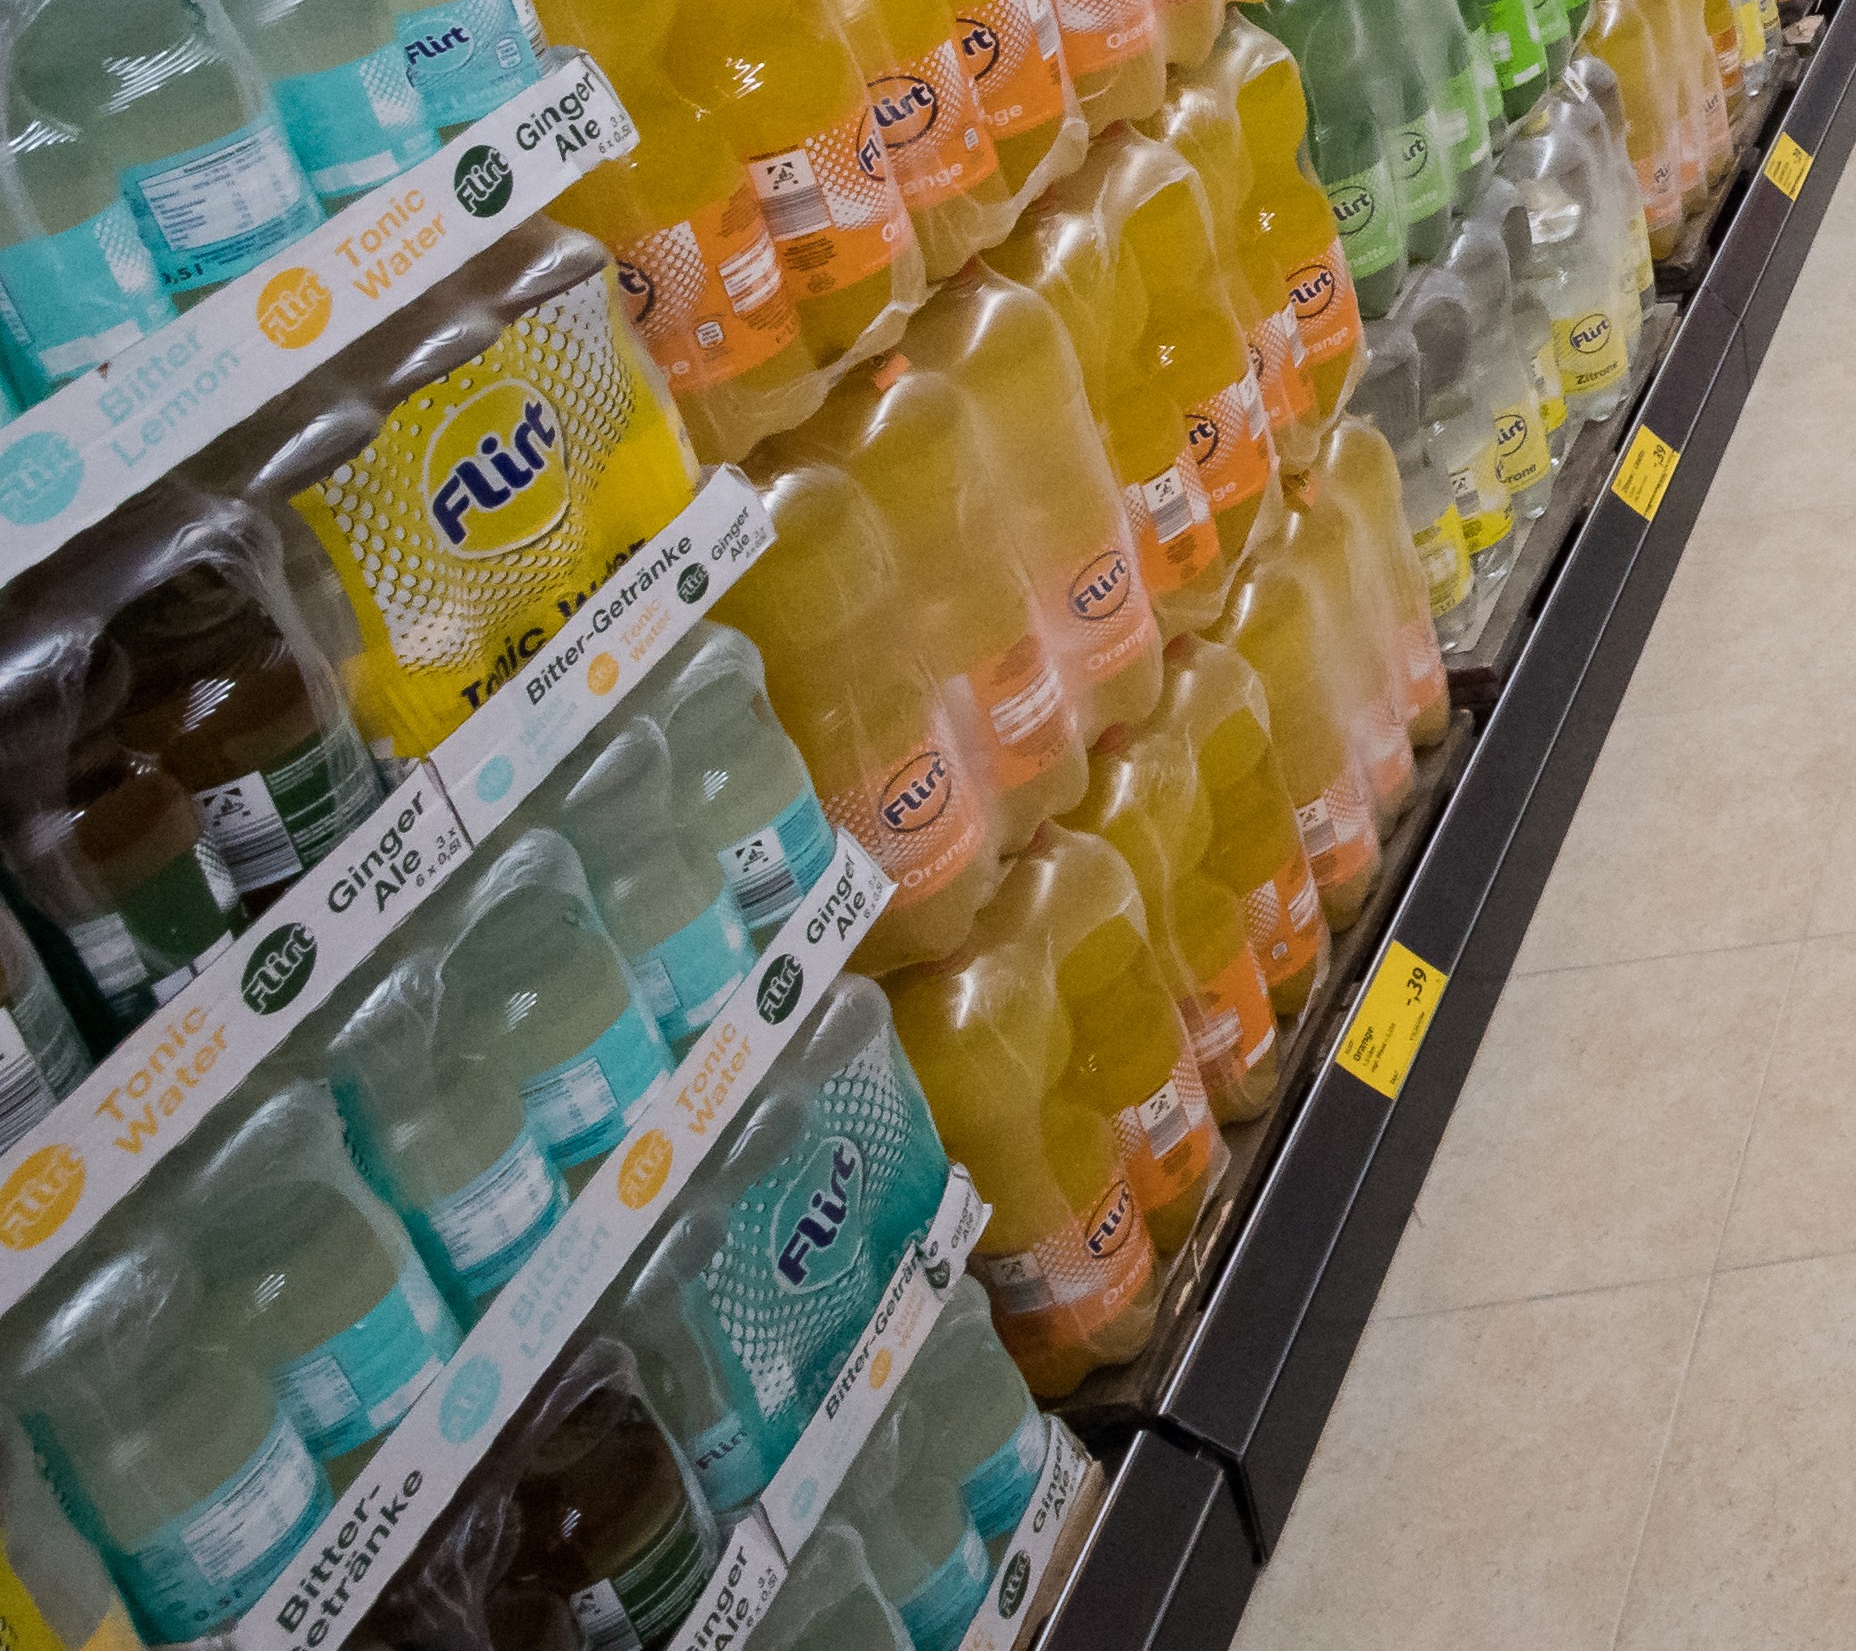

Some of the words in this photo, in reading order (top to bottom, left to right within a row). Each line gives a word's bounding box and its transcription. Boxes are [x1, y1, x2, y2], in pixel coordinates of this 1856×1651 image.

[406, 23, 470, 66] Flirt
[516, 70, 596, 153] Ginger
[554, 115, 602, 163] Ale
[334, 185, 427, 270] Tonic
[457, 149, 511, 214] Flirt
[353, 212, 449, 304] Water
[100, 326, 198, 426] Bitter
[1572, 320, 1609, 349] Flirt
[111, 349, 242, 468] Lemon
[432, 400, 556, 547] Flirt
[525, 533, 694, 706] Bitter-Getränke
[1072, 556, 1127, 615] Flirt
[884, 755, 947, 831] Flirt
[326, 791, 427, 916] Ginger
[374, 847, 422, 913] Ale
[806, 853, 857, 946] Ginger
[835, 890, 868, 942] Ale
[243, 924, 316, 1012] Flirt
[97, 1005, 209, 1124] Tonic
[114, 1023, 232, 1156] Water
[675, 1020, 738, 1112] Tonic
[688, 1034, 755, 1138] Water
[776, 1141, 860, 1289] Flirt
[1087, 1179, 1131, 1257] Flirt
[277, 1483, 383, 1634] Bitter-
